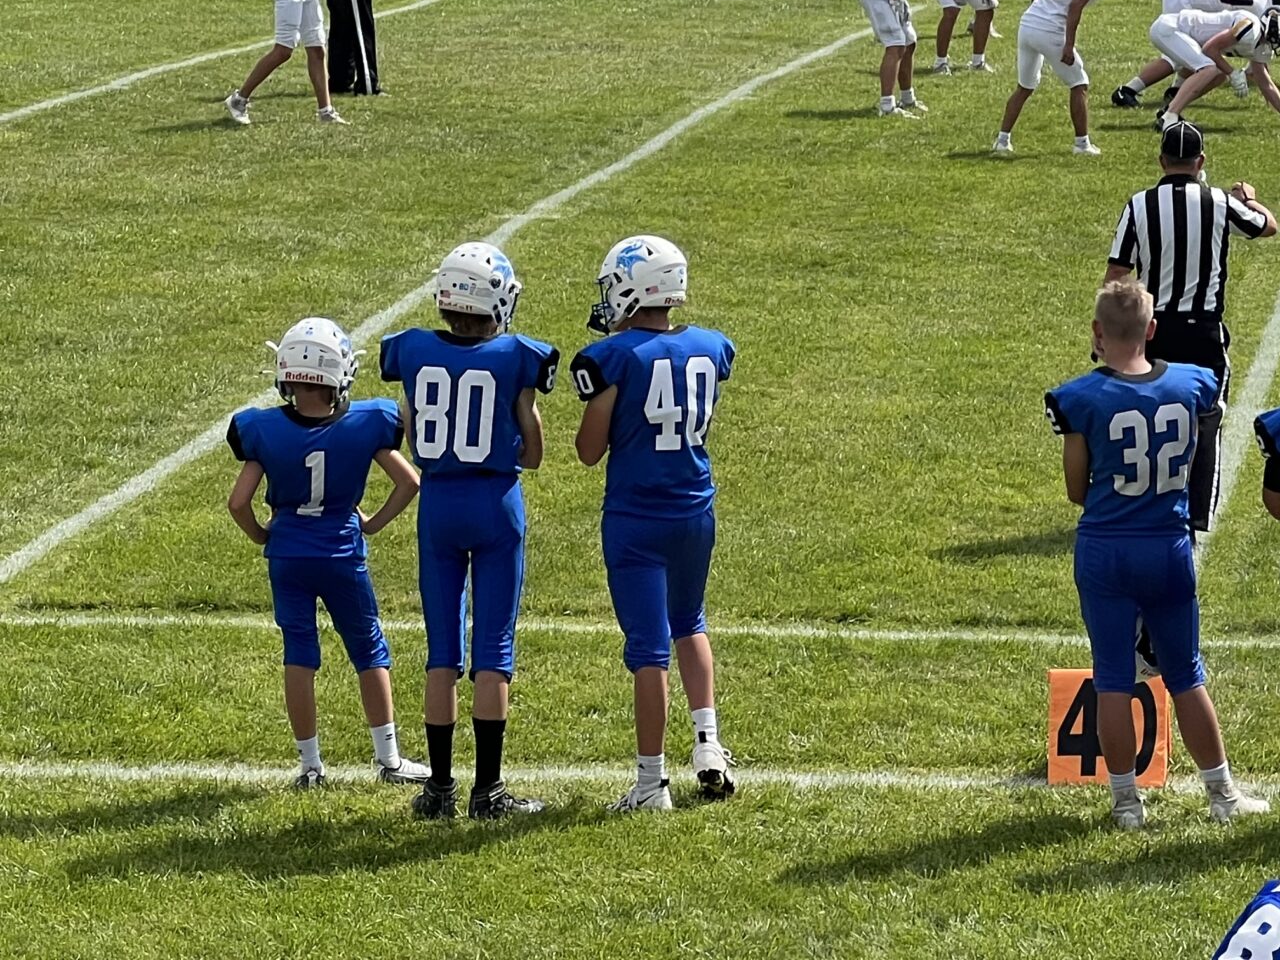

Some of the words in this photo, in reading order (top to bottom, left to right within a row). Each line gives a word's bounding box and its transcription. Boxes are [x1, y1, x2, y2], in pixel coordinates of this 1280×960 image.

[285, 371, 324, 383] Riddell
[414, 366, 496, 463] 80
[644, 356, 718, 451] 40
[296, 450, 325, 517] 1
[1108, 403, 1190, 497] 32
